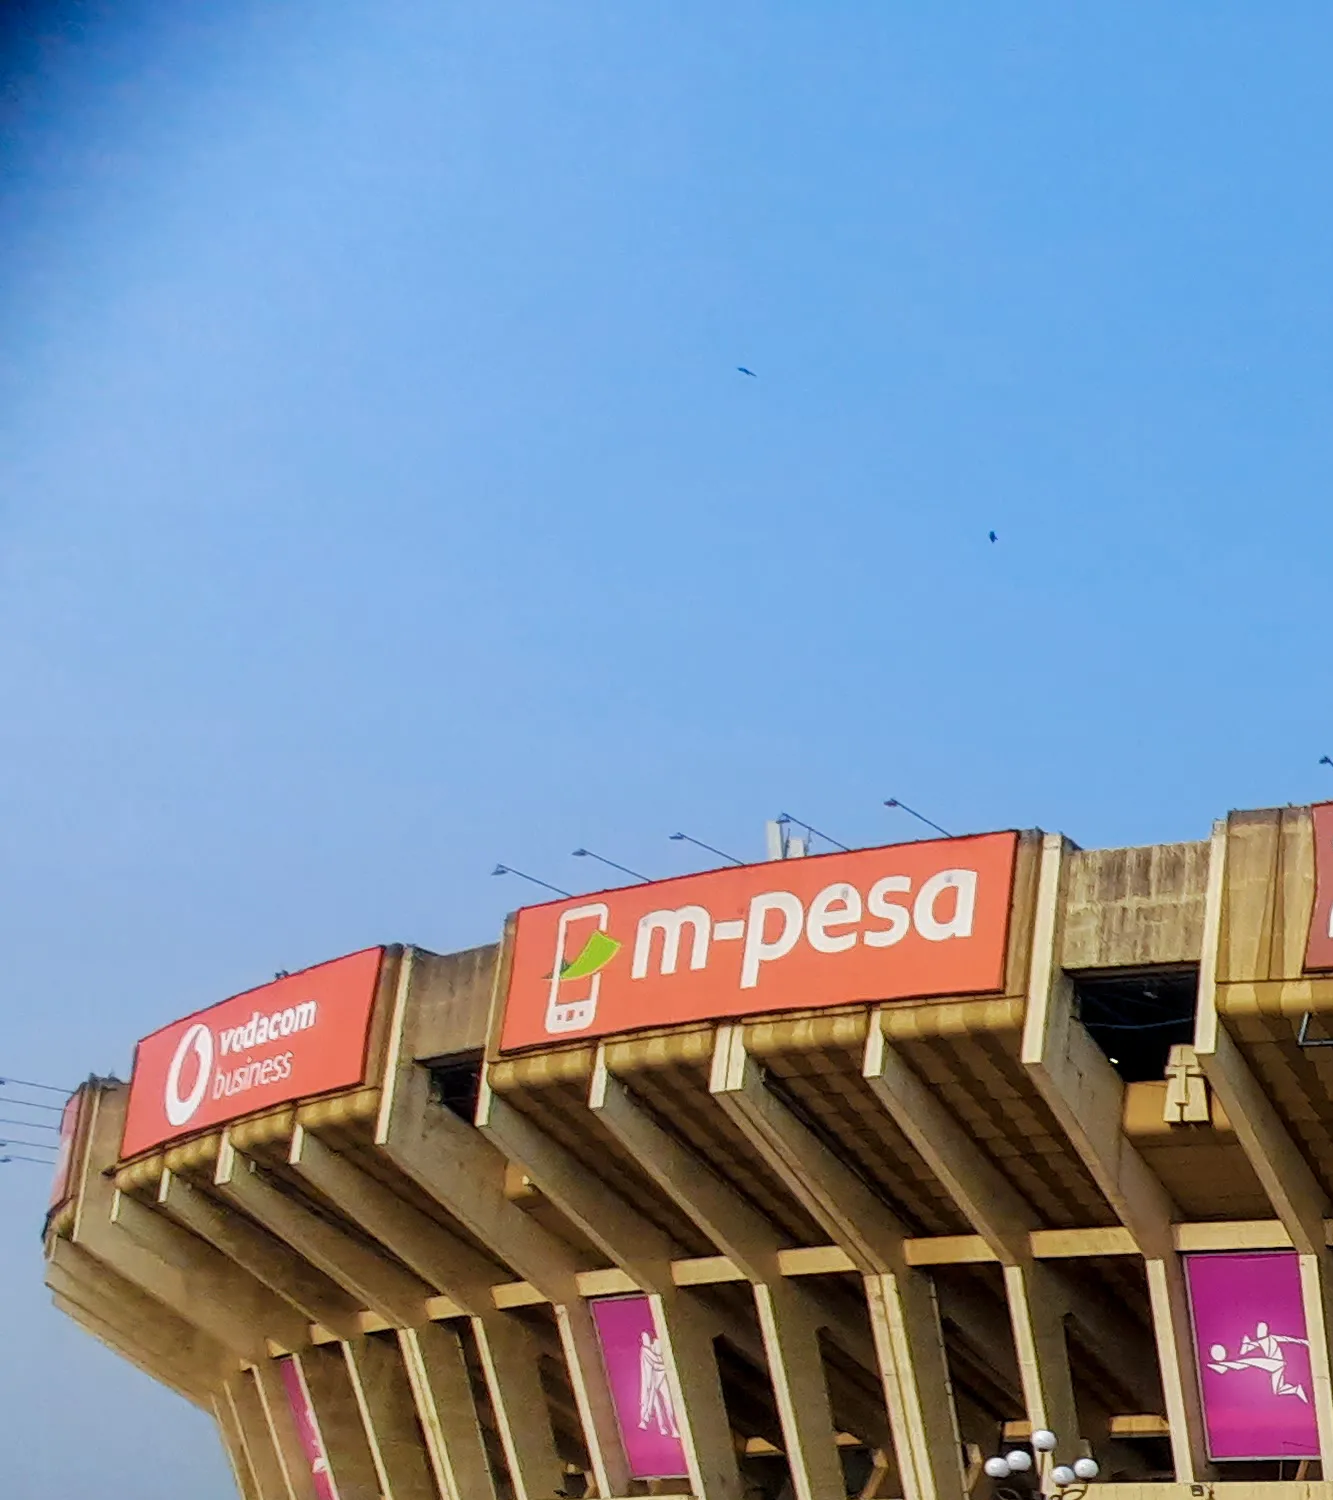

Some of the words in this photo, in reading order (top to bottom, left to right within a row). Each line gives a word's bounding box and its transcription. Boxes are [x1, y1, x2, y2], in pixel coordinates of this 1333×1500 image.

[631, 868, 979, 989] m-pesa
[219, 1000, 318, 1056] vodacom
[211, 1051, 294, 1100] business
